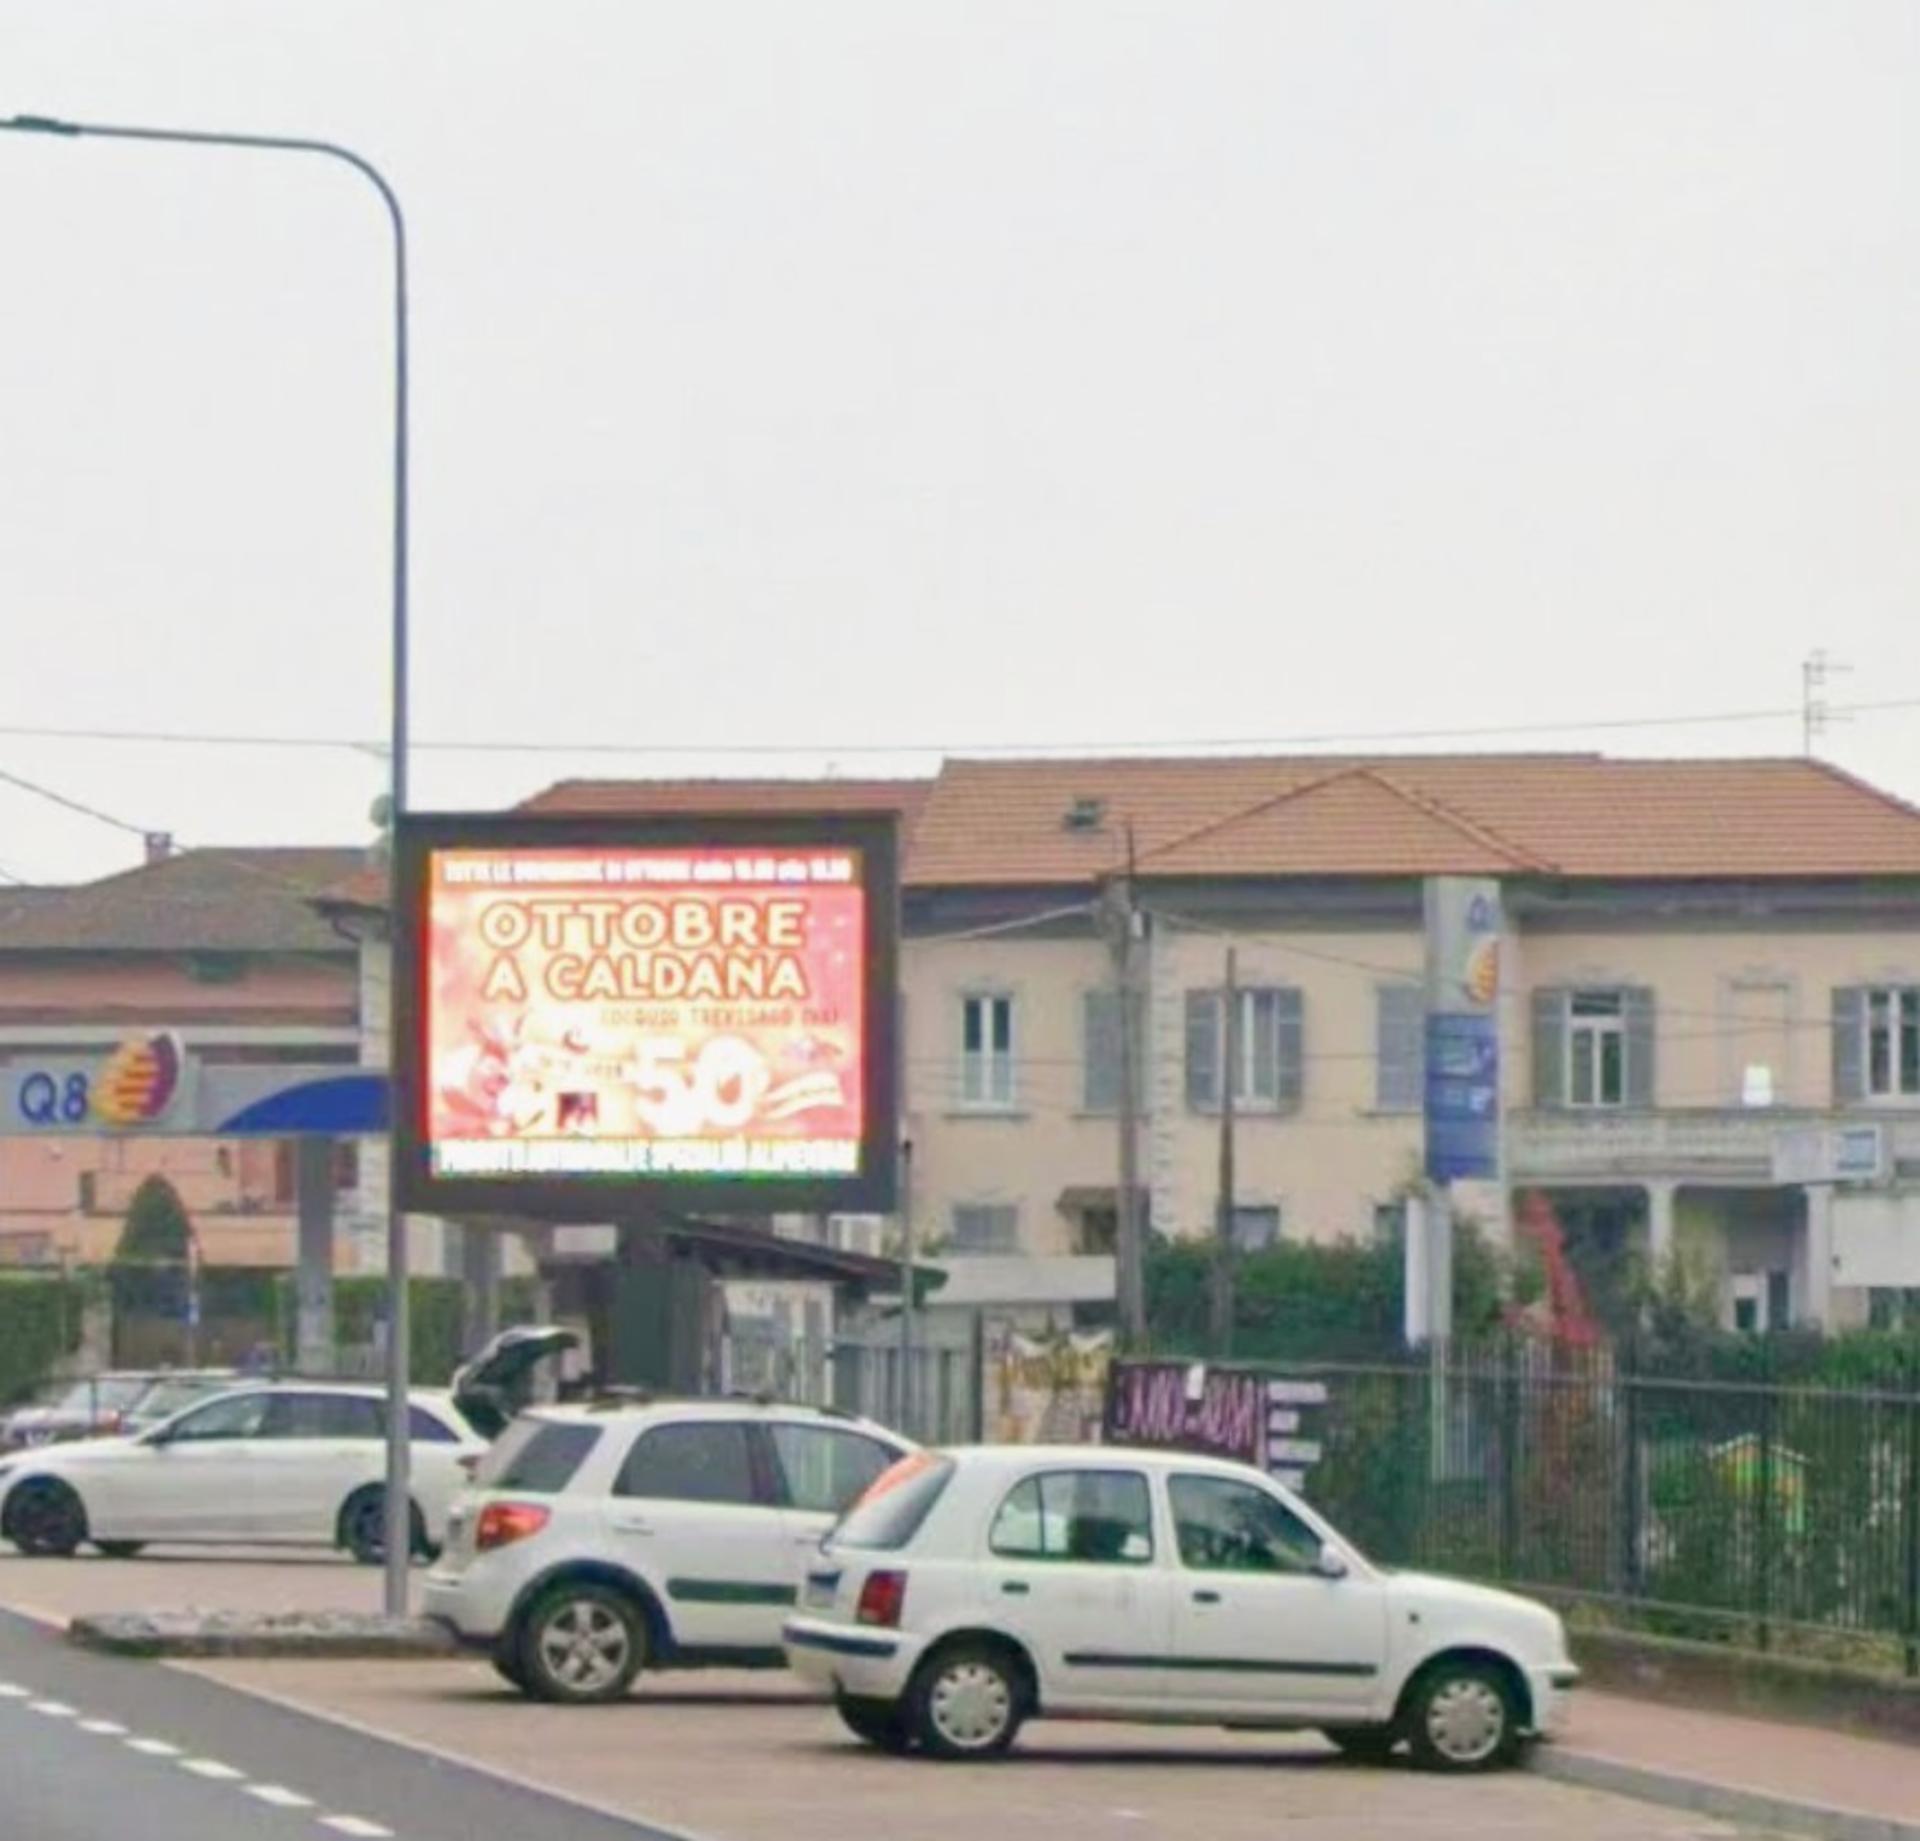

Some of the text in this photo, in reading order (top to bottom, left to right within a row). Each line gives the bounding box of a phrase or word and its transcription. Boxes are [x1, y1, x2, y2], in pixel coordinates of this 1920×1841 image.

[482, 901, 805, 949] OTTOBRE
[484, 954, 808, 1000] A CALDANA
[19, 1072, 89, 1124] Q8
[634, 1036, 769, 1132] 50
